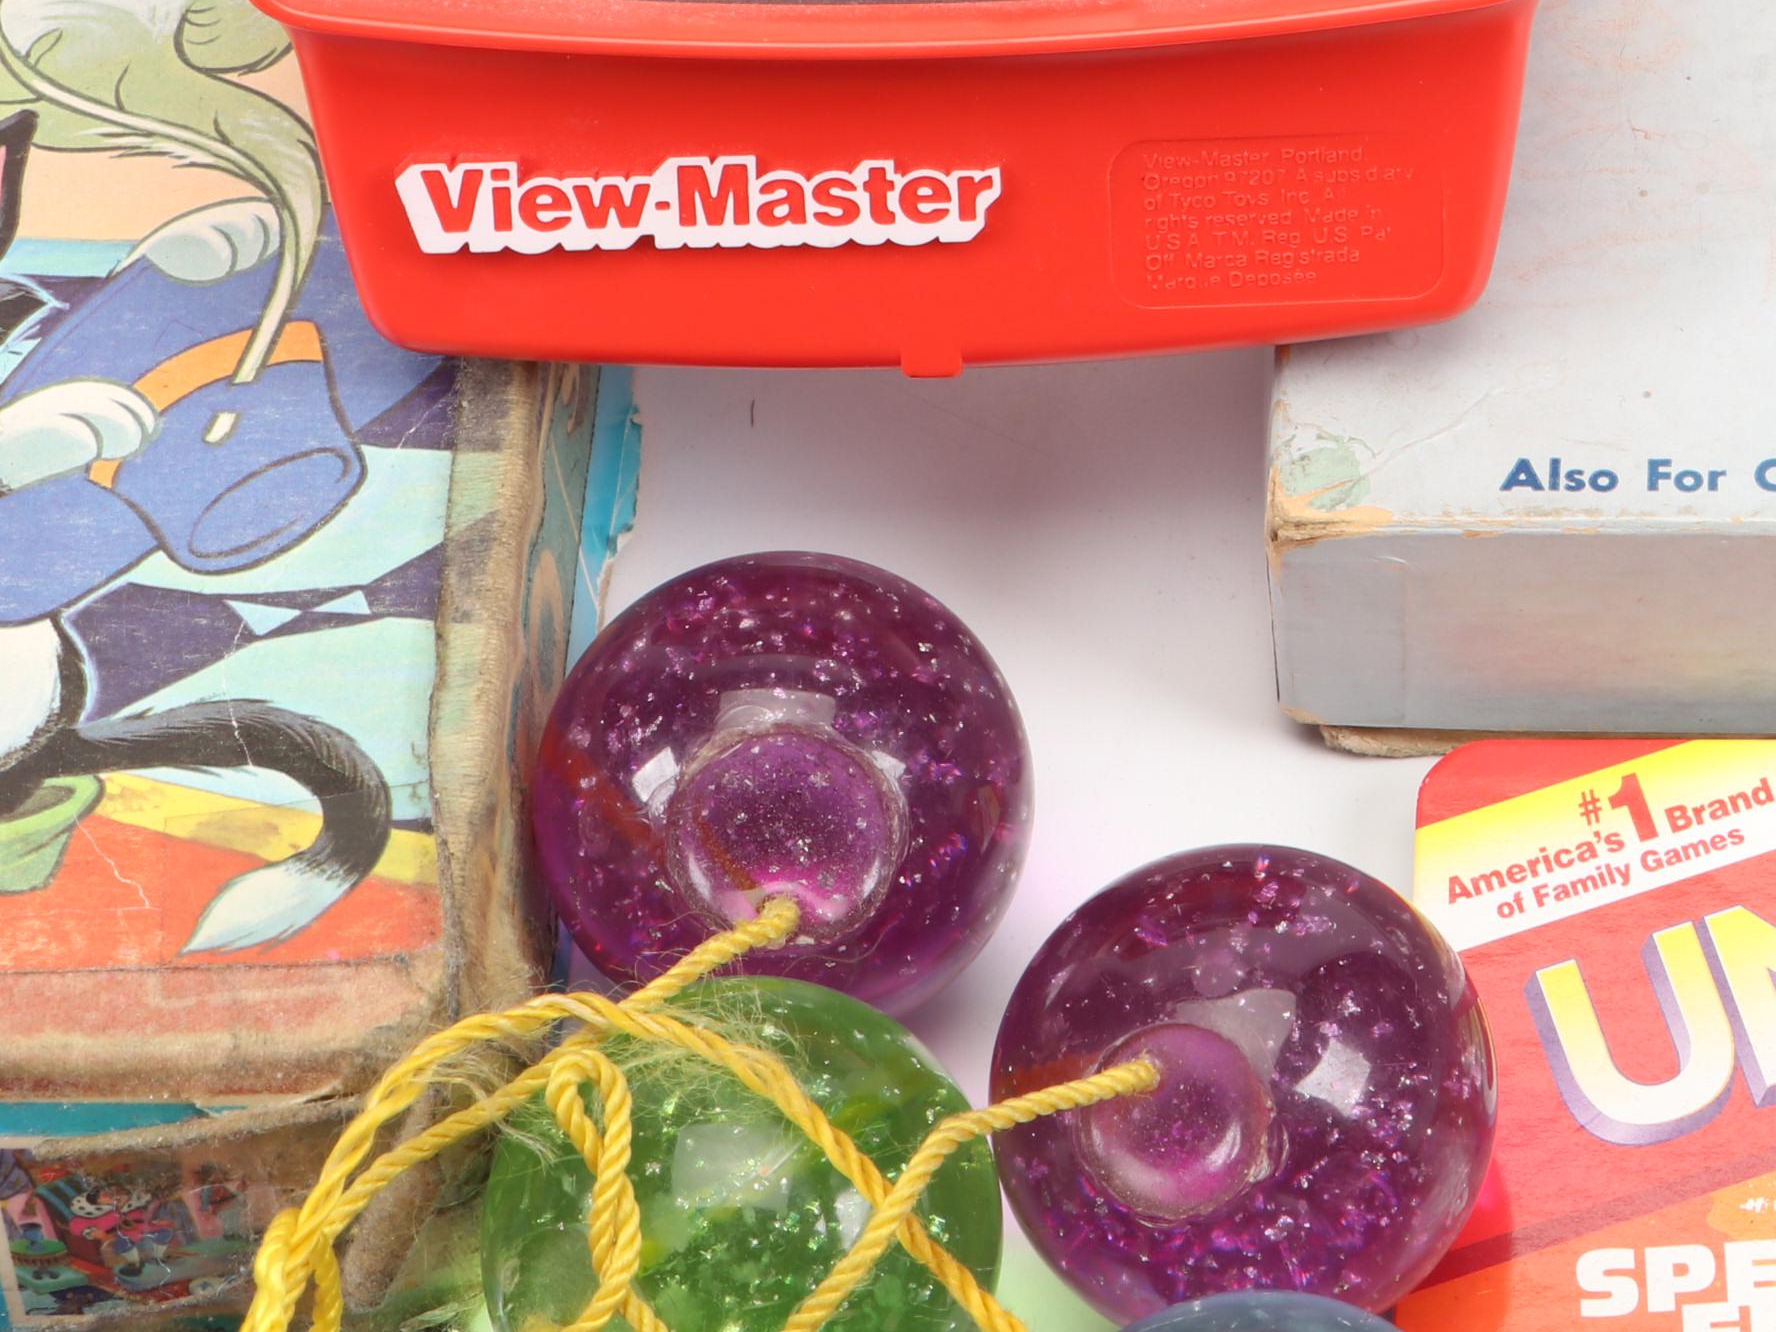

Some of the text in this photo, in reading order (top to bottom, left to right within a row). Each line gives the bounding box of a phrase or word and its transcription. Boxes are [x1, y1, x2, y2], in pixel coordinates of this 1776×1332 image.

[1144, 150, 1269, 170] View-Master
[1314, 166, 1414, 184] subsdary
[404, 158, 998, 244] View-Master
[1168, 192, 1216, 212] Tyco
[1145, 214, 1199, 235] rghts
[1254, 246, 1360, 270] Regstrada
[1500, 457, 1618, 493] Also
[1646, 457, 1727, 493] For
[1446, 771, 1776, 905] America's #1 Brand
[1496, 824, 1747, 921] of Family Games
